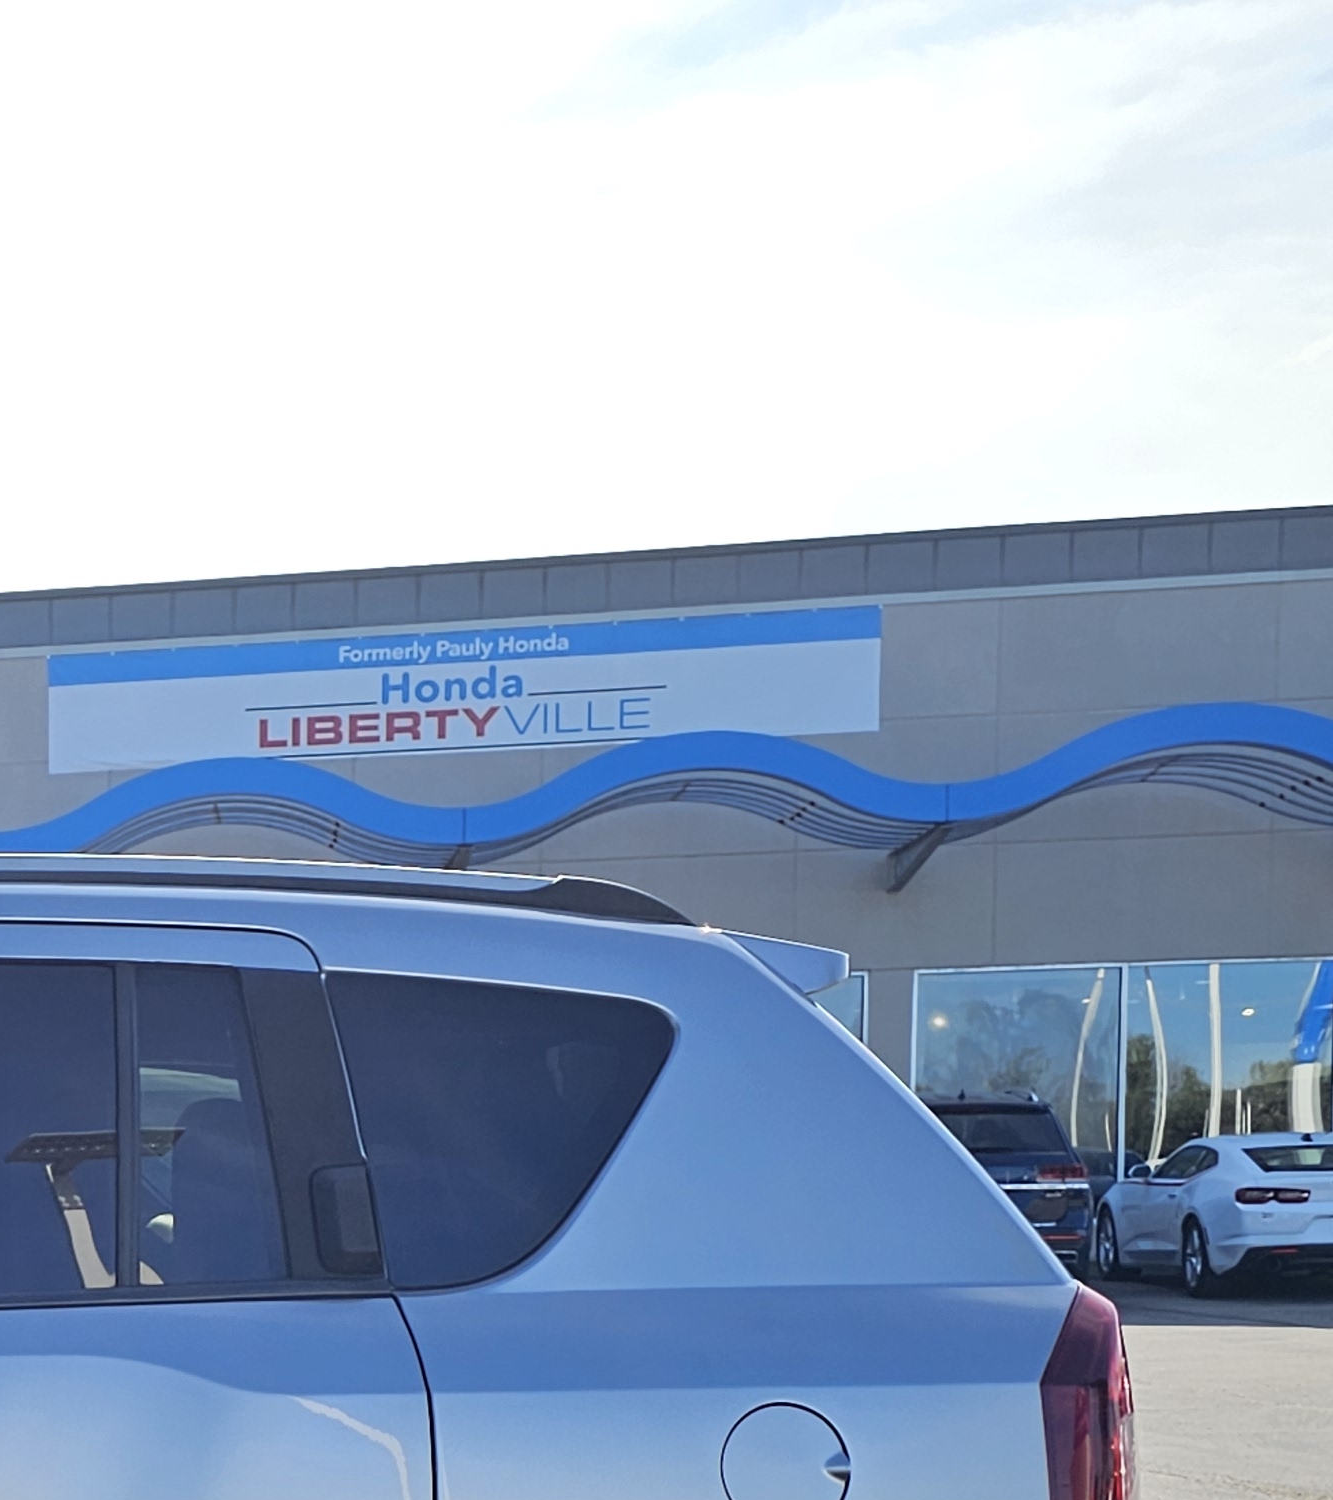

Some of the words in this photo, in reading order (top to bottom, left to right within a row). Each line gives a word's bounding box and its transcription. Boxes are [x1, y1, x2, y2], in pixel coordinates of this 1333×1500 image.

[338, 640, 432, 664] Formerly
[436, 637, 493, 660] Pauly
[498, 632, 570, 654] Honda
[381, 664, 524, 706] Honda
[258, 697, 651, 749] LIBERTYVILLE
